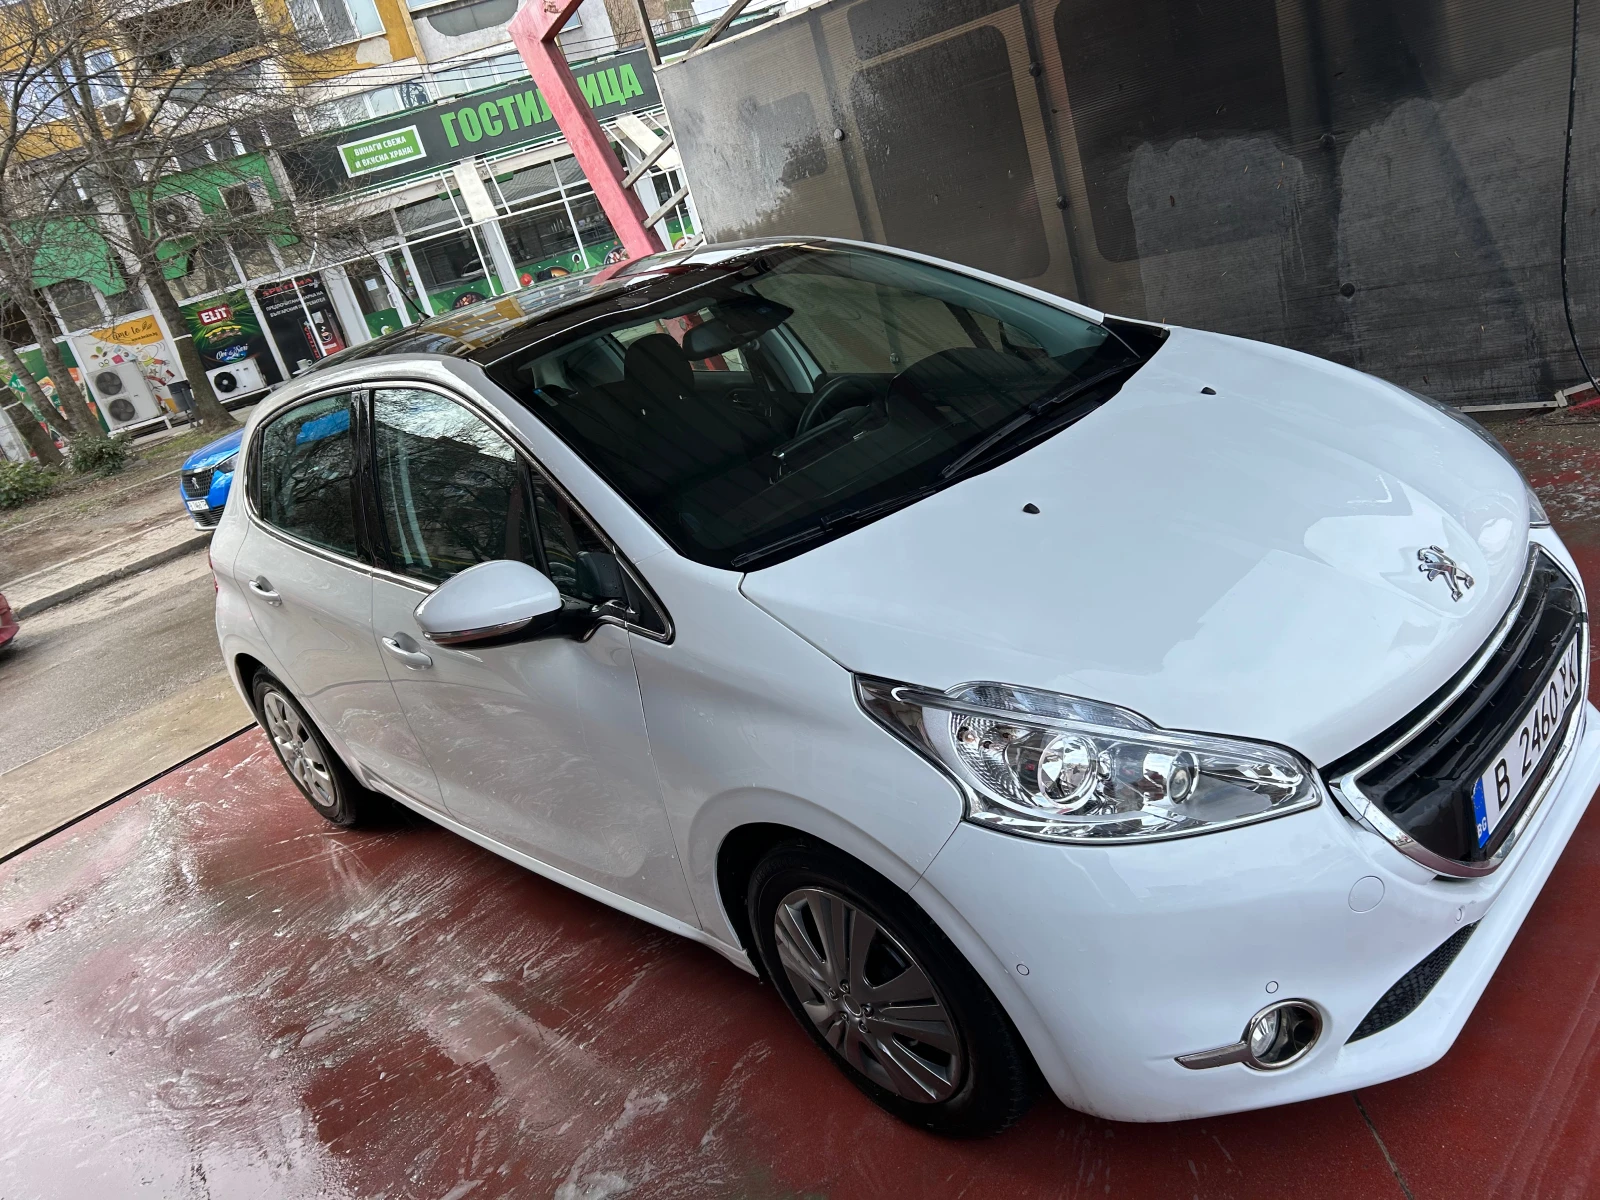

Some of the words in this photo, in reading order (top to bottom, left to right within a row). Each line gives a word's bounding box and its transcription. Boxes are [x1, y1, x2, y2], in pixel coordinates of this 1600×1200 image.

[439, 63, 645, 148] ГОСТИИЦА
[354, 142, 383, 157] ВИНАГИ
[383, 135, 407, 149] СВЕЖА
[389, 145, 414, 159] ХРАНА!
[265, 298, 301, 311] ПРЕДПОЧИТАН
[1494, 757, 1511, 812] B
[1518, 680, 1558, 779] 2460
[1476, 816, 1487, 839] BG
